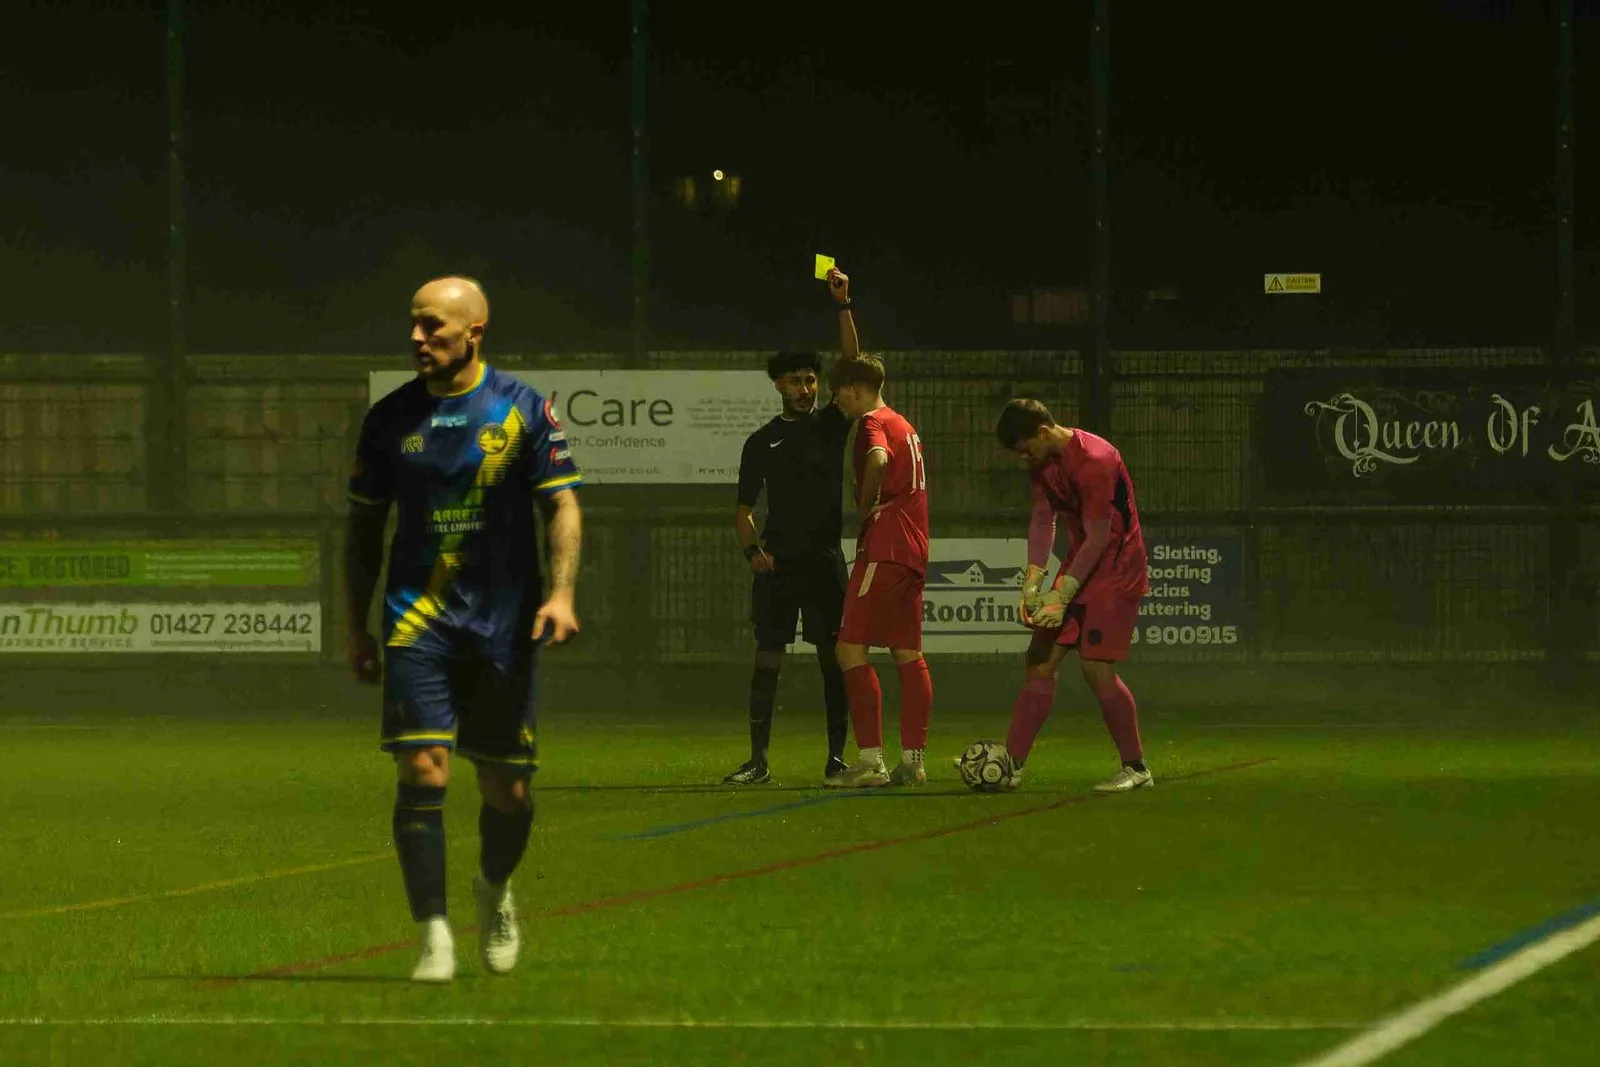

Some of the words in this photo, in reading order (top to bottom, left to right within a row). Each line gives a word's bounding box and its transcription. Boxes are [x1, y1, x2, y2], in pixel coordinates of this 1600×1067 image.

[566, 389, 673, 426] Care
[586, 436, 666, 448] Confidence
[1304, 393, 1459, 477] Queen
[1487, 393, 1541, 457] Of
[905, 432, 926, 490] 15
[1153, 545, 1223, 565] Slating,
[923, 596, 1022, 624] Roofin
[150, 613, 216, 635] 01427
[224, 613, 313, 635] 238442
[1146, 626, 1238, 645] 900915
